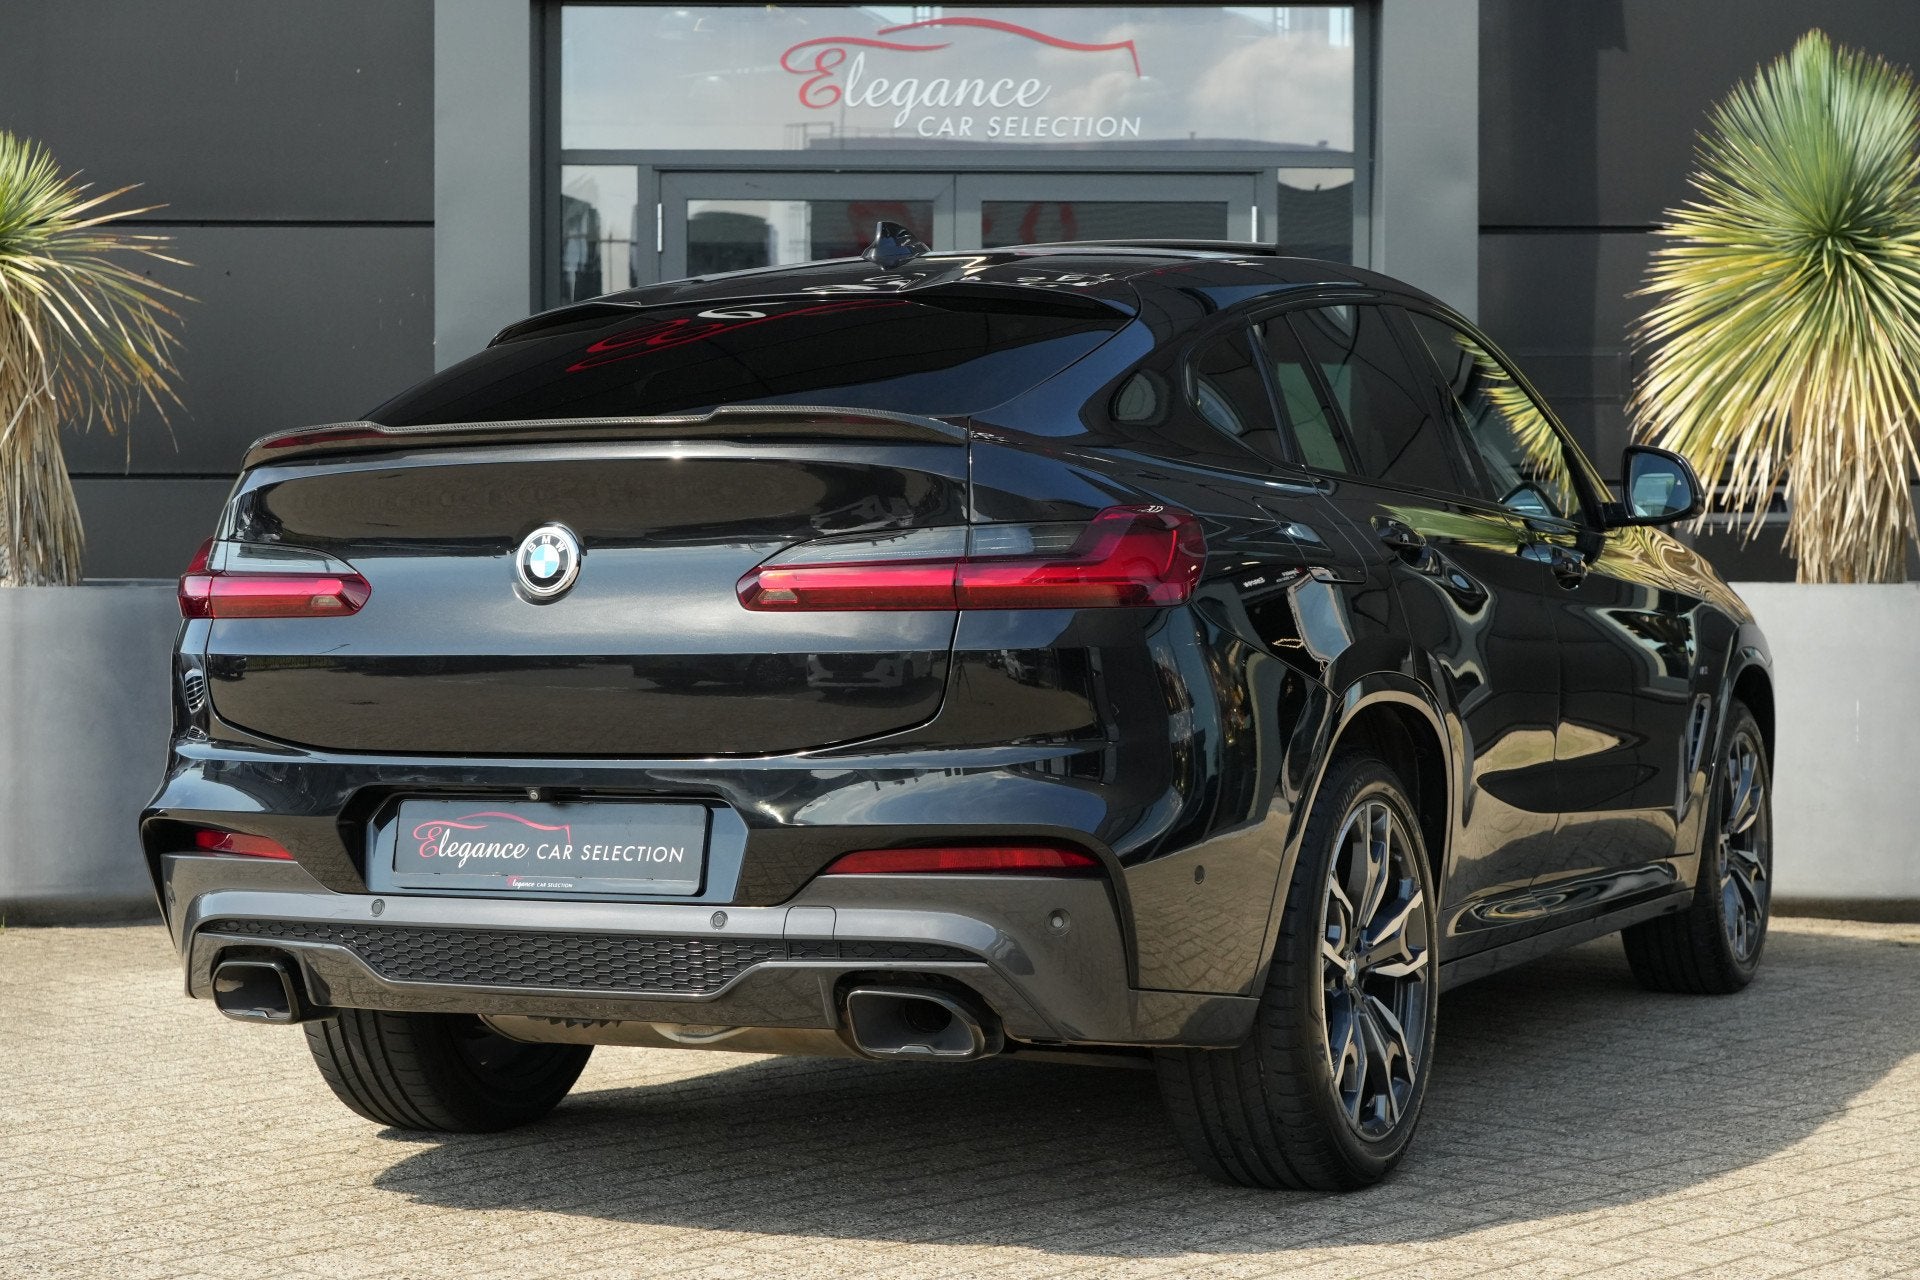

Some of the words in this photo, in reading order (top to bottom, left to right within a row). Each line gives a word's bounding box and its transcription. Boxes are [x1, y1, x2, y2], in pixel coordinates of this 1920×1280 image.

[781, 47, 1052, 129] Elegance
[917, 116, 972, 138] CAR
[987, 116, 1141, 138] SELECTION
[528, 534, 567, 553] BMW
[414, 826, 530, 868] Elegance
[536, 844, 573, 860] CAR
[581, 845, 684, 863] SELECTION
